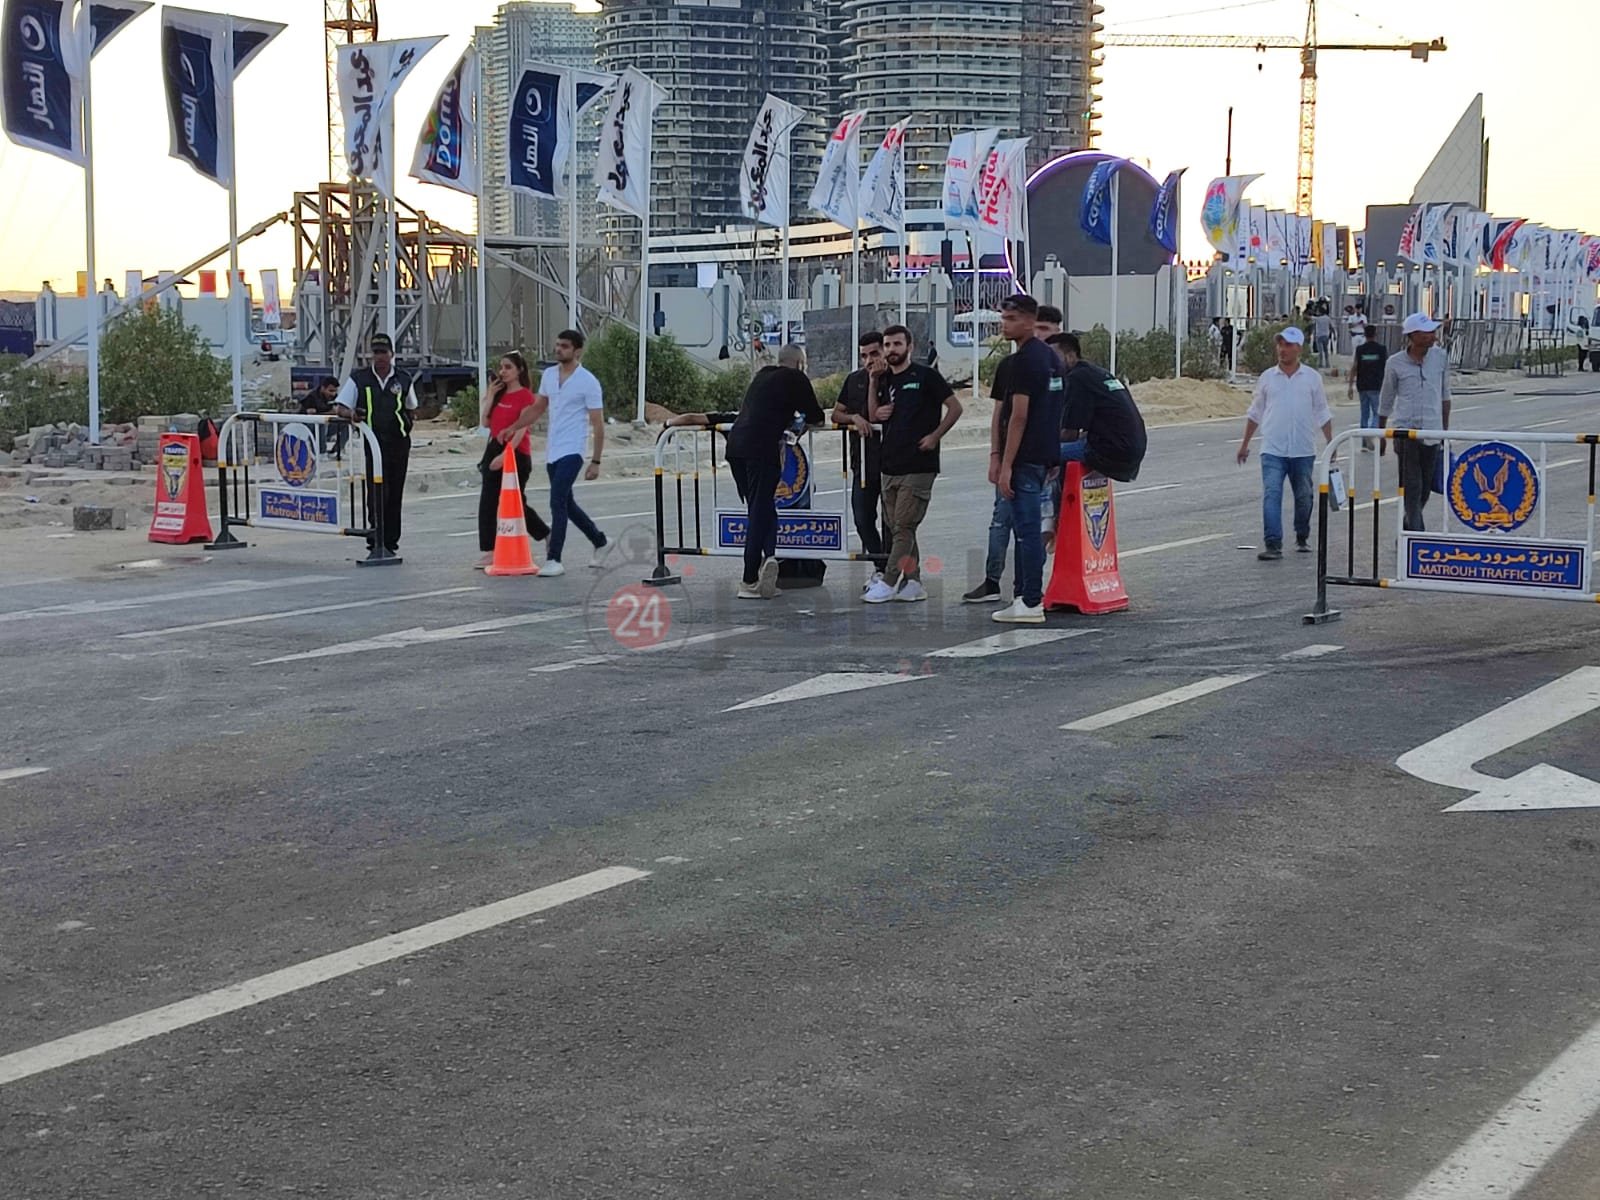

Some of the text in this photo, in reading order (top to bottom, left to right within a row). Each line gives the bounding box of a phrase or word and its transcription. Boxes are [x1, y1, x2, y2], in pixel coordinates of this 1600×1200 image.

[21, 62, 55, 131] النهار
[521, 124, 541, 180] النهار
[303, 511, 329, 523] traffic
[777, 521, 838, 534] إدارة مرور
[777, 535, 837, 545] TRAFFIC DEPT.
[1417, 548, 1570, 568] إدارة مرور مطروح
[1418, 564, 1567, 583] MATROUH TRAFFIC DEPT.
